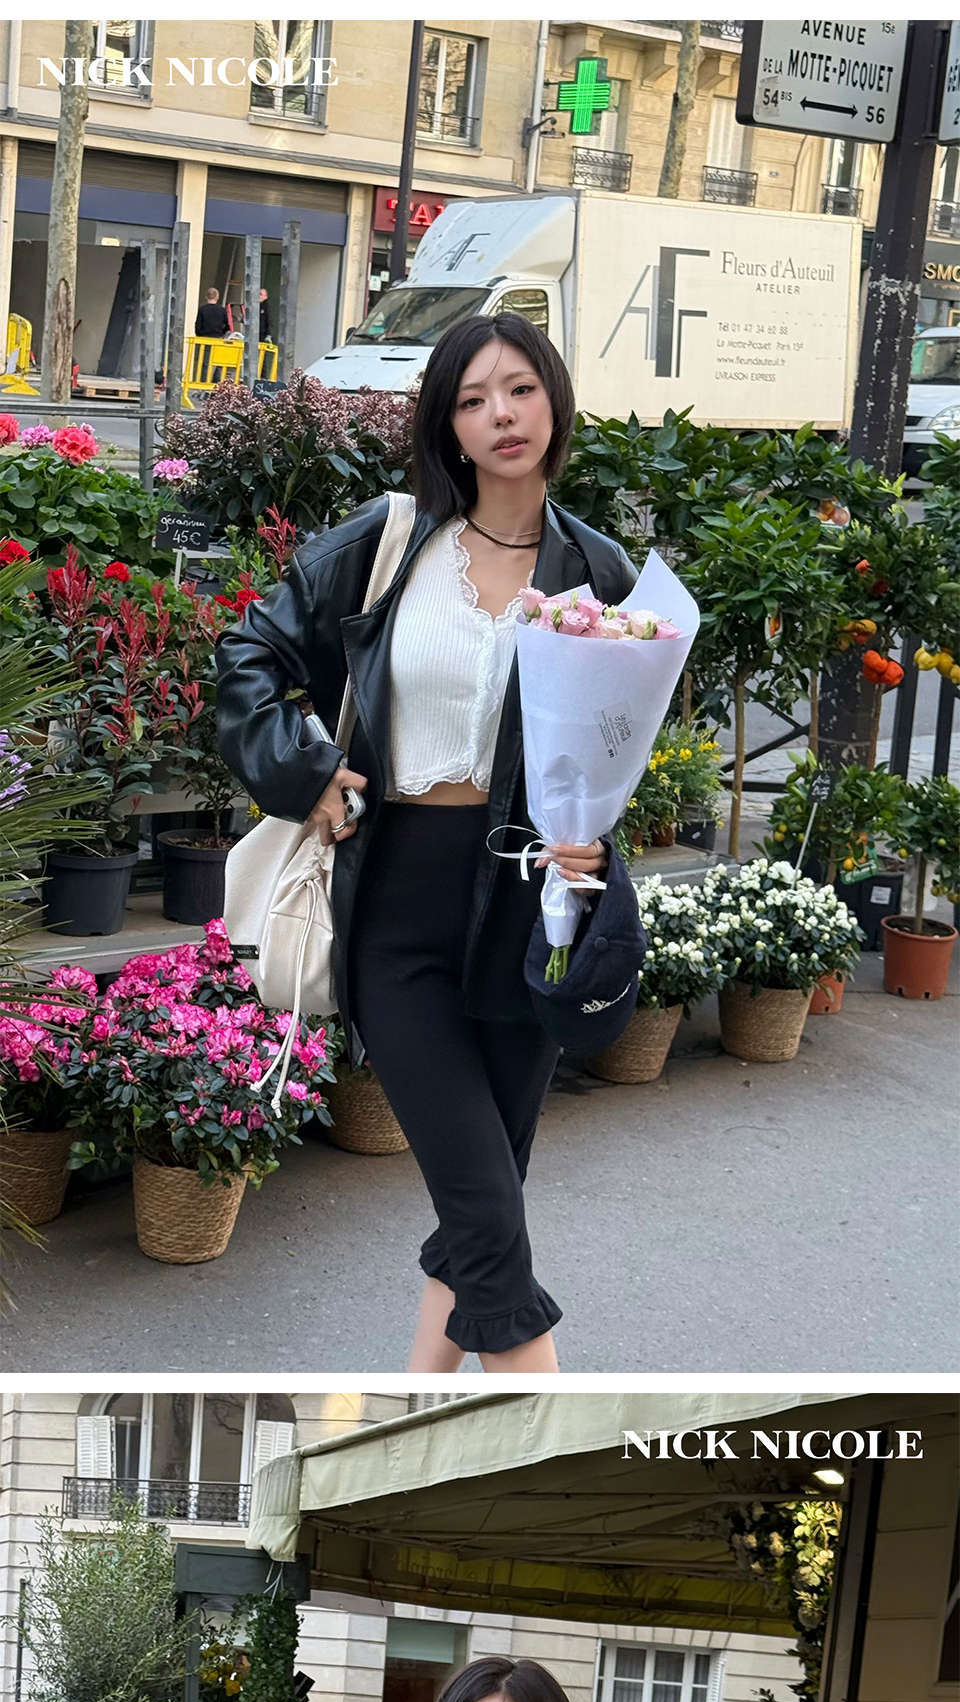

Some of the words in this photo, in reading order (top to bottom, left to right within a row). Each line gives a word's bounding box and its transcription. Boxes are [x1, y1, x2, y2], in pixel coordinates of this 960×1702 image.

[801, 20, 867, 46] AVENUE
[763, 58, 773, 74] DE
[775, 60, 783, 76] LA
[787, 49, 894, 94] MOTTE-PICQUET
[763, 88, 779, 107] 54
[781, 91, 793, 102] BIS
[865, 106, 886, 125] 56
[720, 250, 767, 278] Fleurs
[770, 256, 835, 283] d'Auteuil
[755, 283, 802, 296] ATELIER
[750, 372, 777, 382] EXPRESS
[172, 529, 202, 546] 45€
